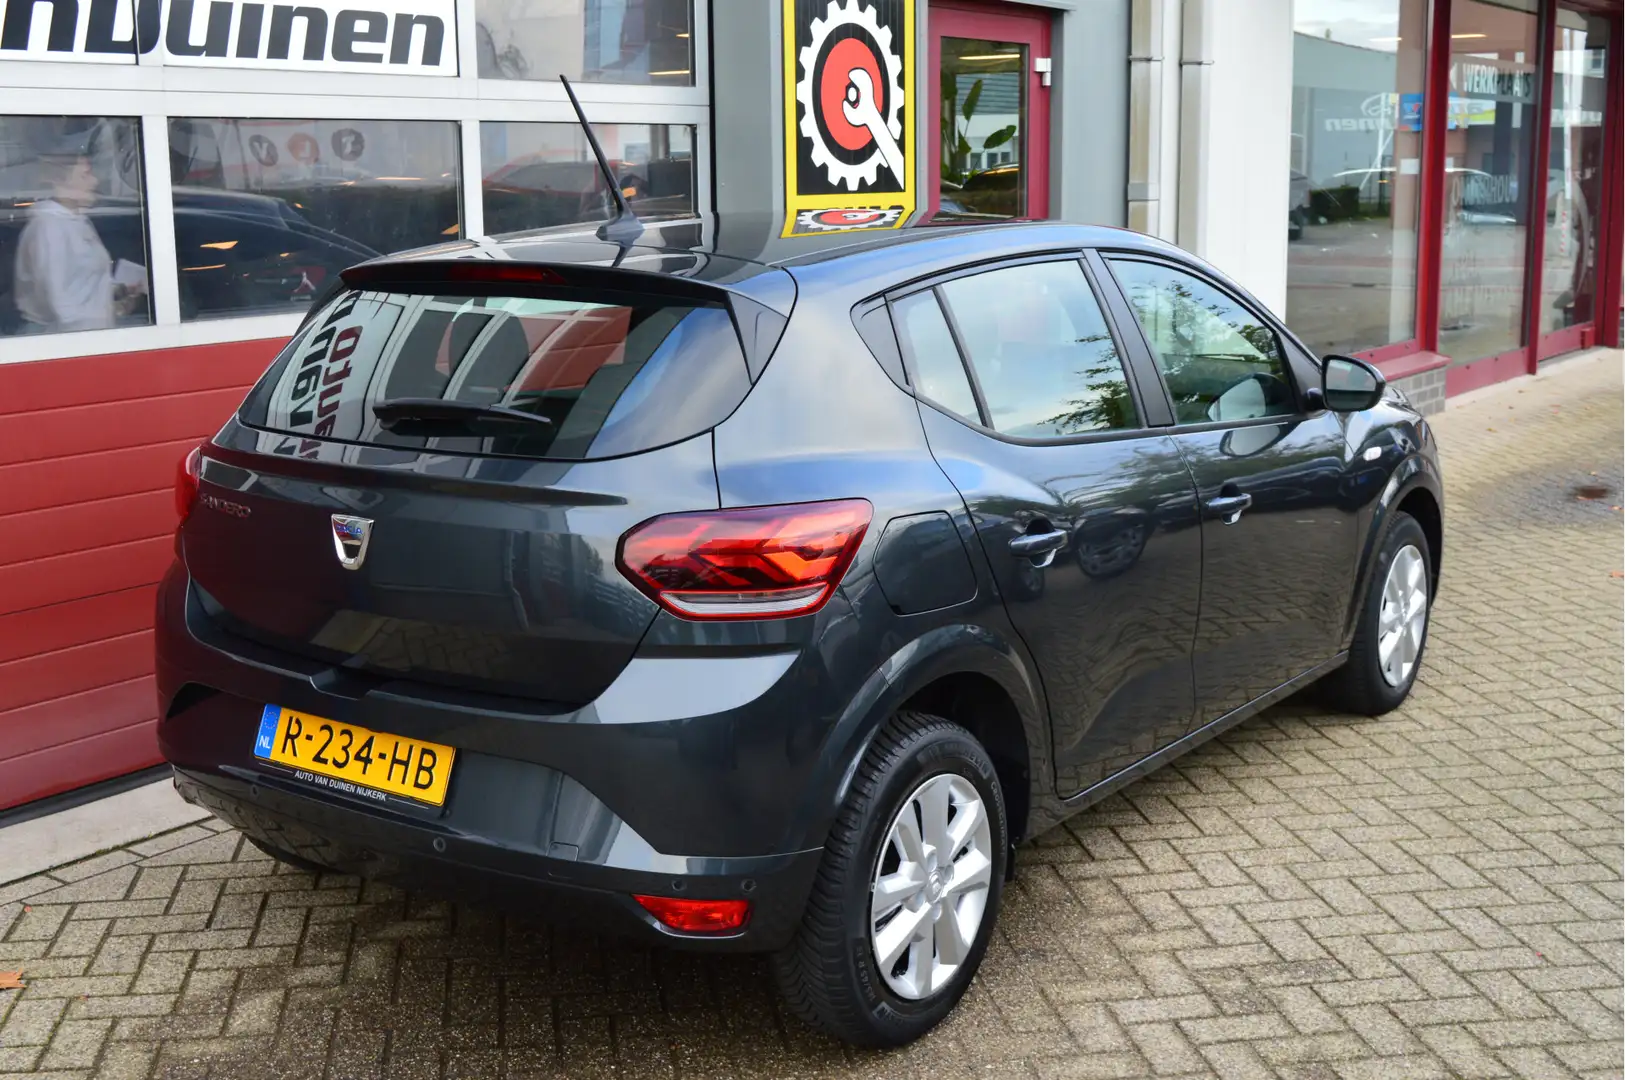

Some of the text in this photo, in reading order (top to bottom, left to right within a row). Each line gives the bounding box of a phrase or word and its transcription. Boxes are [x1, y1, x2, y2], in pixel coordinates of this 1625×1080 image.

[1463, 63, 1531, 98] WERKPLAATS
[200, 492, 251, 519] SANDERO
[259, 735, 271, 750] NL
[281, 715, 437, 790] R-234-HB
[294, 770, 387, 801] AUTO VAN DUINEN NIJKERK
